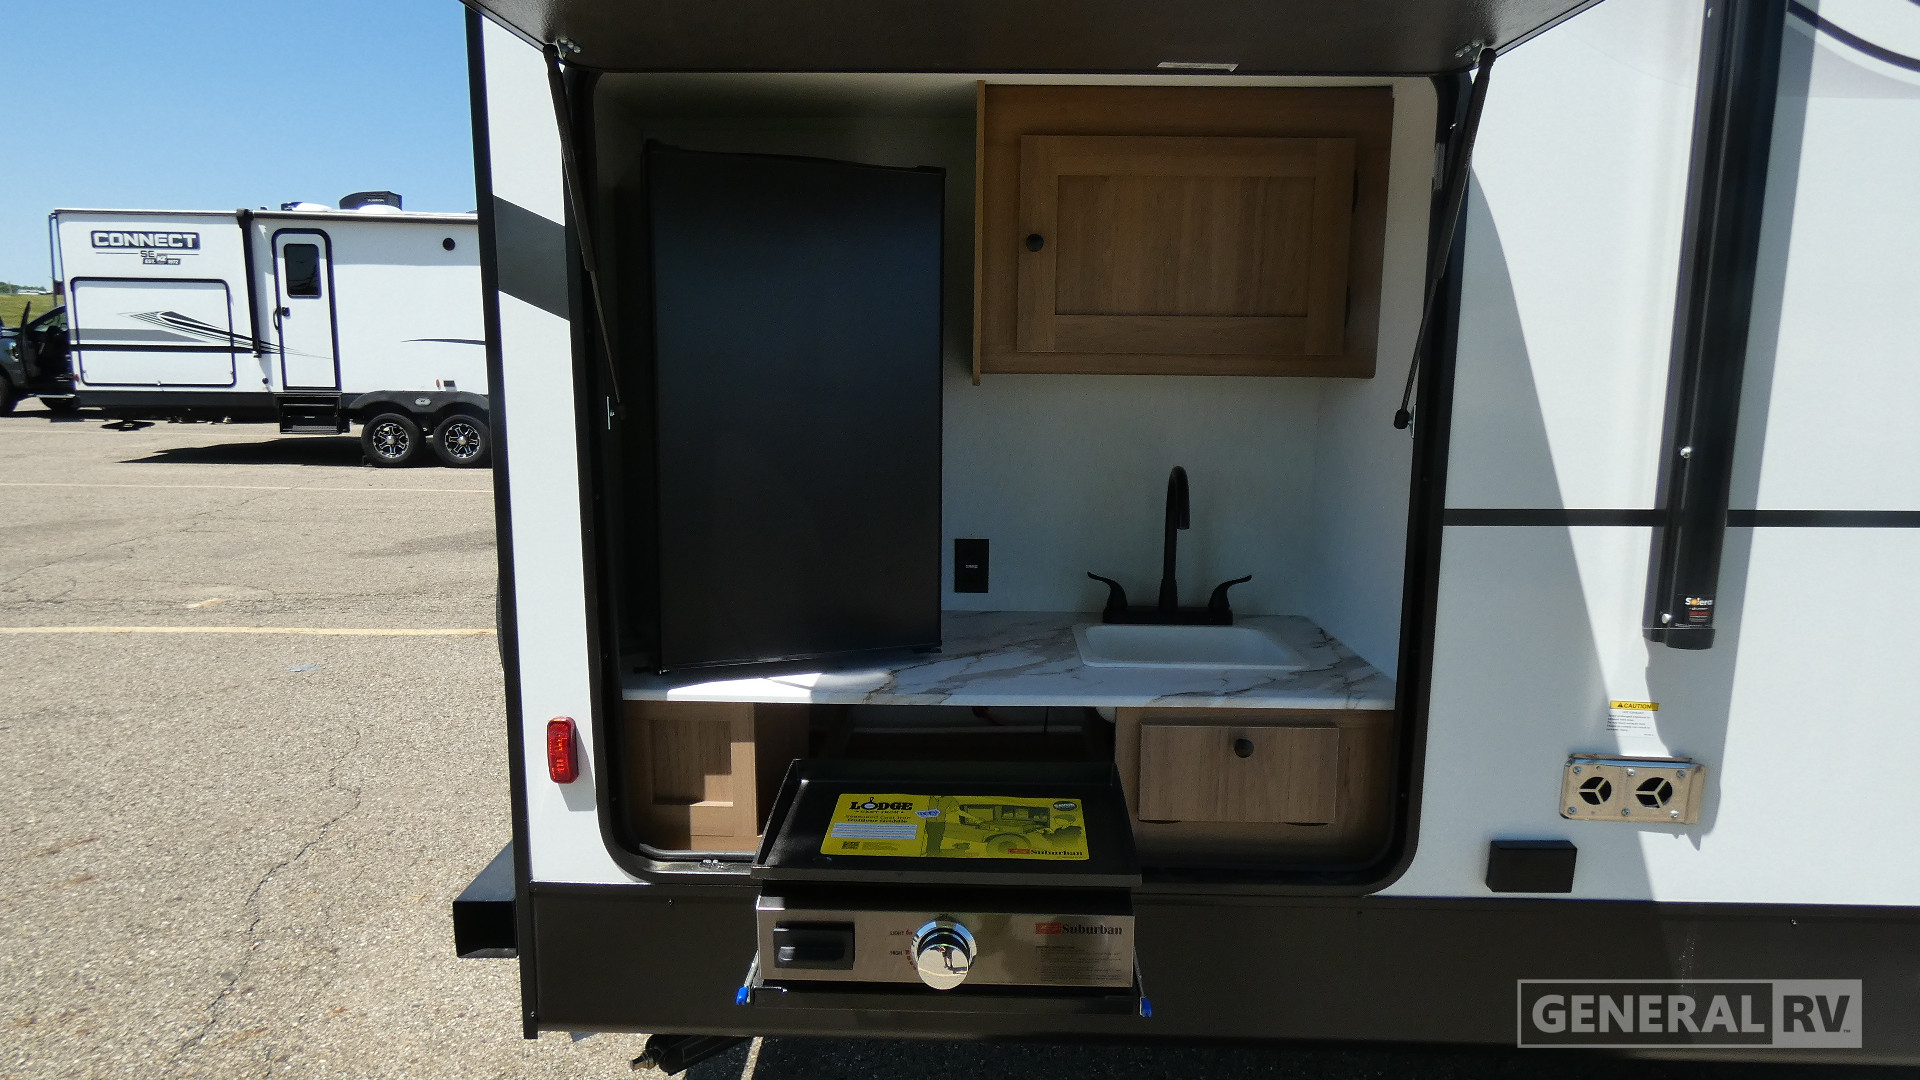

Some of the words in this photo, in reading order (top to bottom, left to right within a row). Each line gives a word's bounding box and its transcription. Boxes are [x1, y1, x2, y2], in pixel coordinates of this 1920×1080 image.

[93, 232, 197, 248] CONNECT
[140, 250, 155, 258] SE
[1623, 702, 1653, 710] CAUTION
[849, 797, 913, 811] LODGE
[1061, 923, 1123, 936] Suburban
